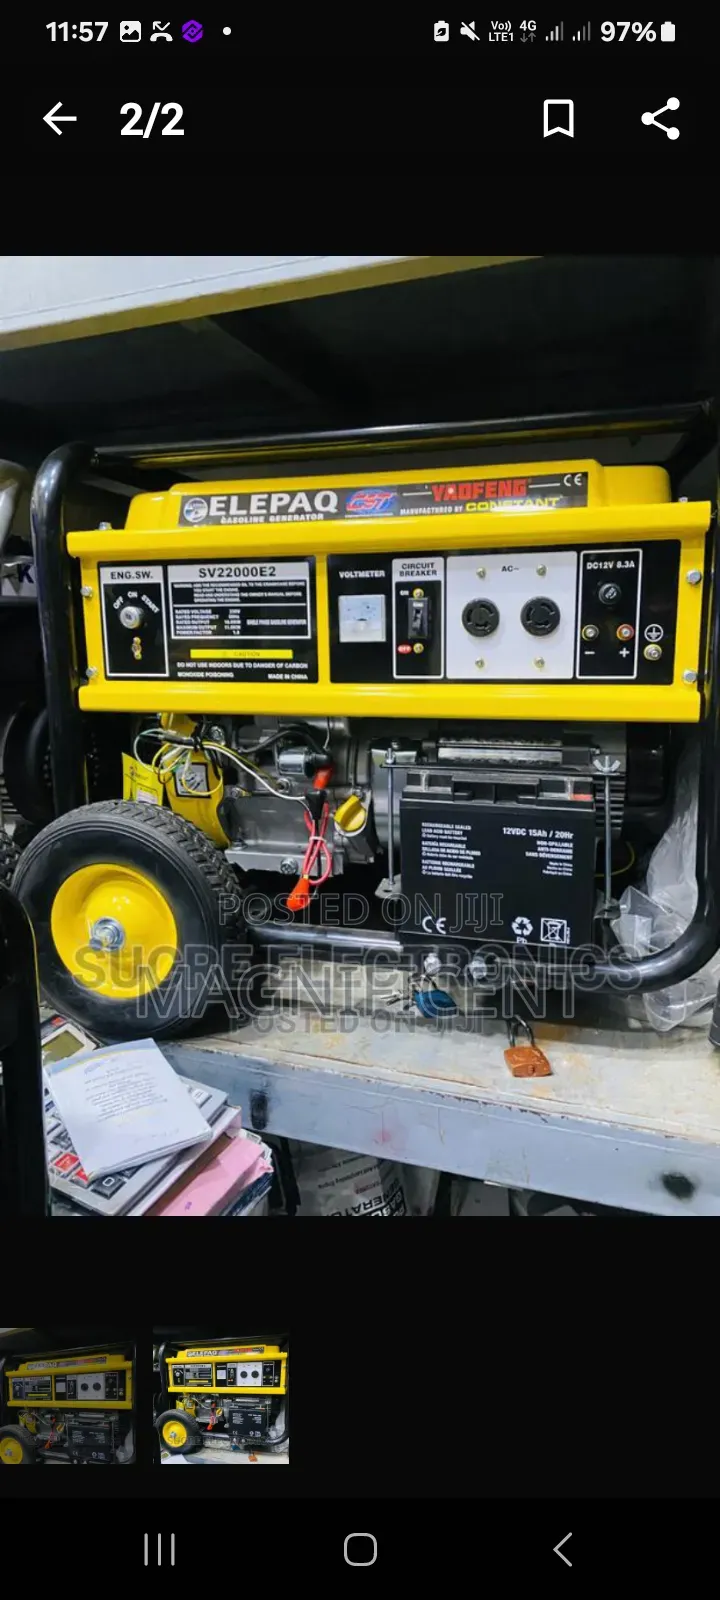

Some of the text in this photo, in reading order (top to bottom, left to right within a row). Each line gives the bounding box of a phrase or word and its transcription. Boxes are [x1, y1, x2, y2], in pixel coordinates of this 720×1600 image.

[46, 21, 109, 42] 11:57
[520, 20, 537, 32] 4G
[600, 21, 657, 43] 97%
[489, 32, 513, 42] LTE1
[119, 102, 185, 139] 2/2
[209, 490, 338, 516] ELEPAQ
[454, 505, 463, 513] BY
[465, 497, 560, 512] CONSTANT
[221, 513, 324, 524] GASOLINE GENERATOR
[401, 562, 435, 570] CIRCUIT
[586, 560, 636, 570] DC12V 8.3A
[110, 571, 153, 580] ENG.SW.
[198, 566, 276, 578] SV22000E2
[338, 570, 386, 579] VOLTMETER
[113, 596, 123, 609] OFF
[141, 594, 160, 613] START
[502, 827, 527, 836] 12VDC
[528, 828, 548, 838] 15Ah
[554, 831, 574, 839] 20Hr
